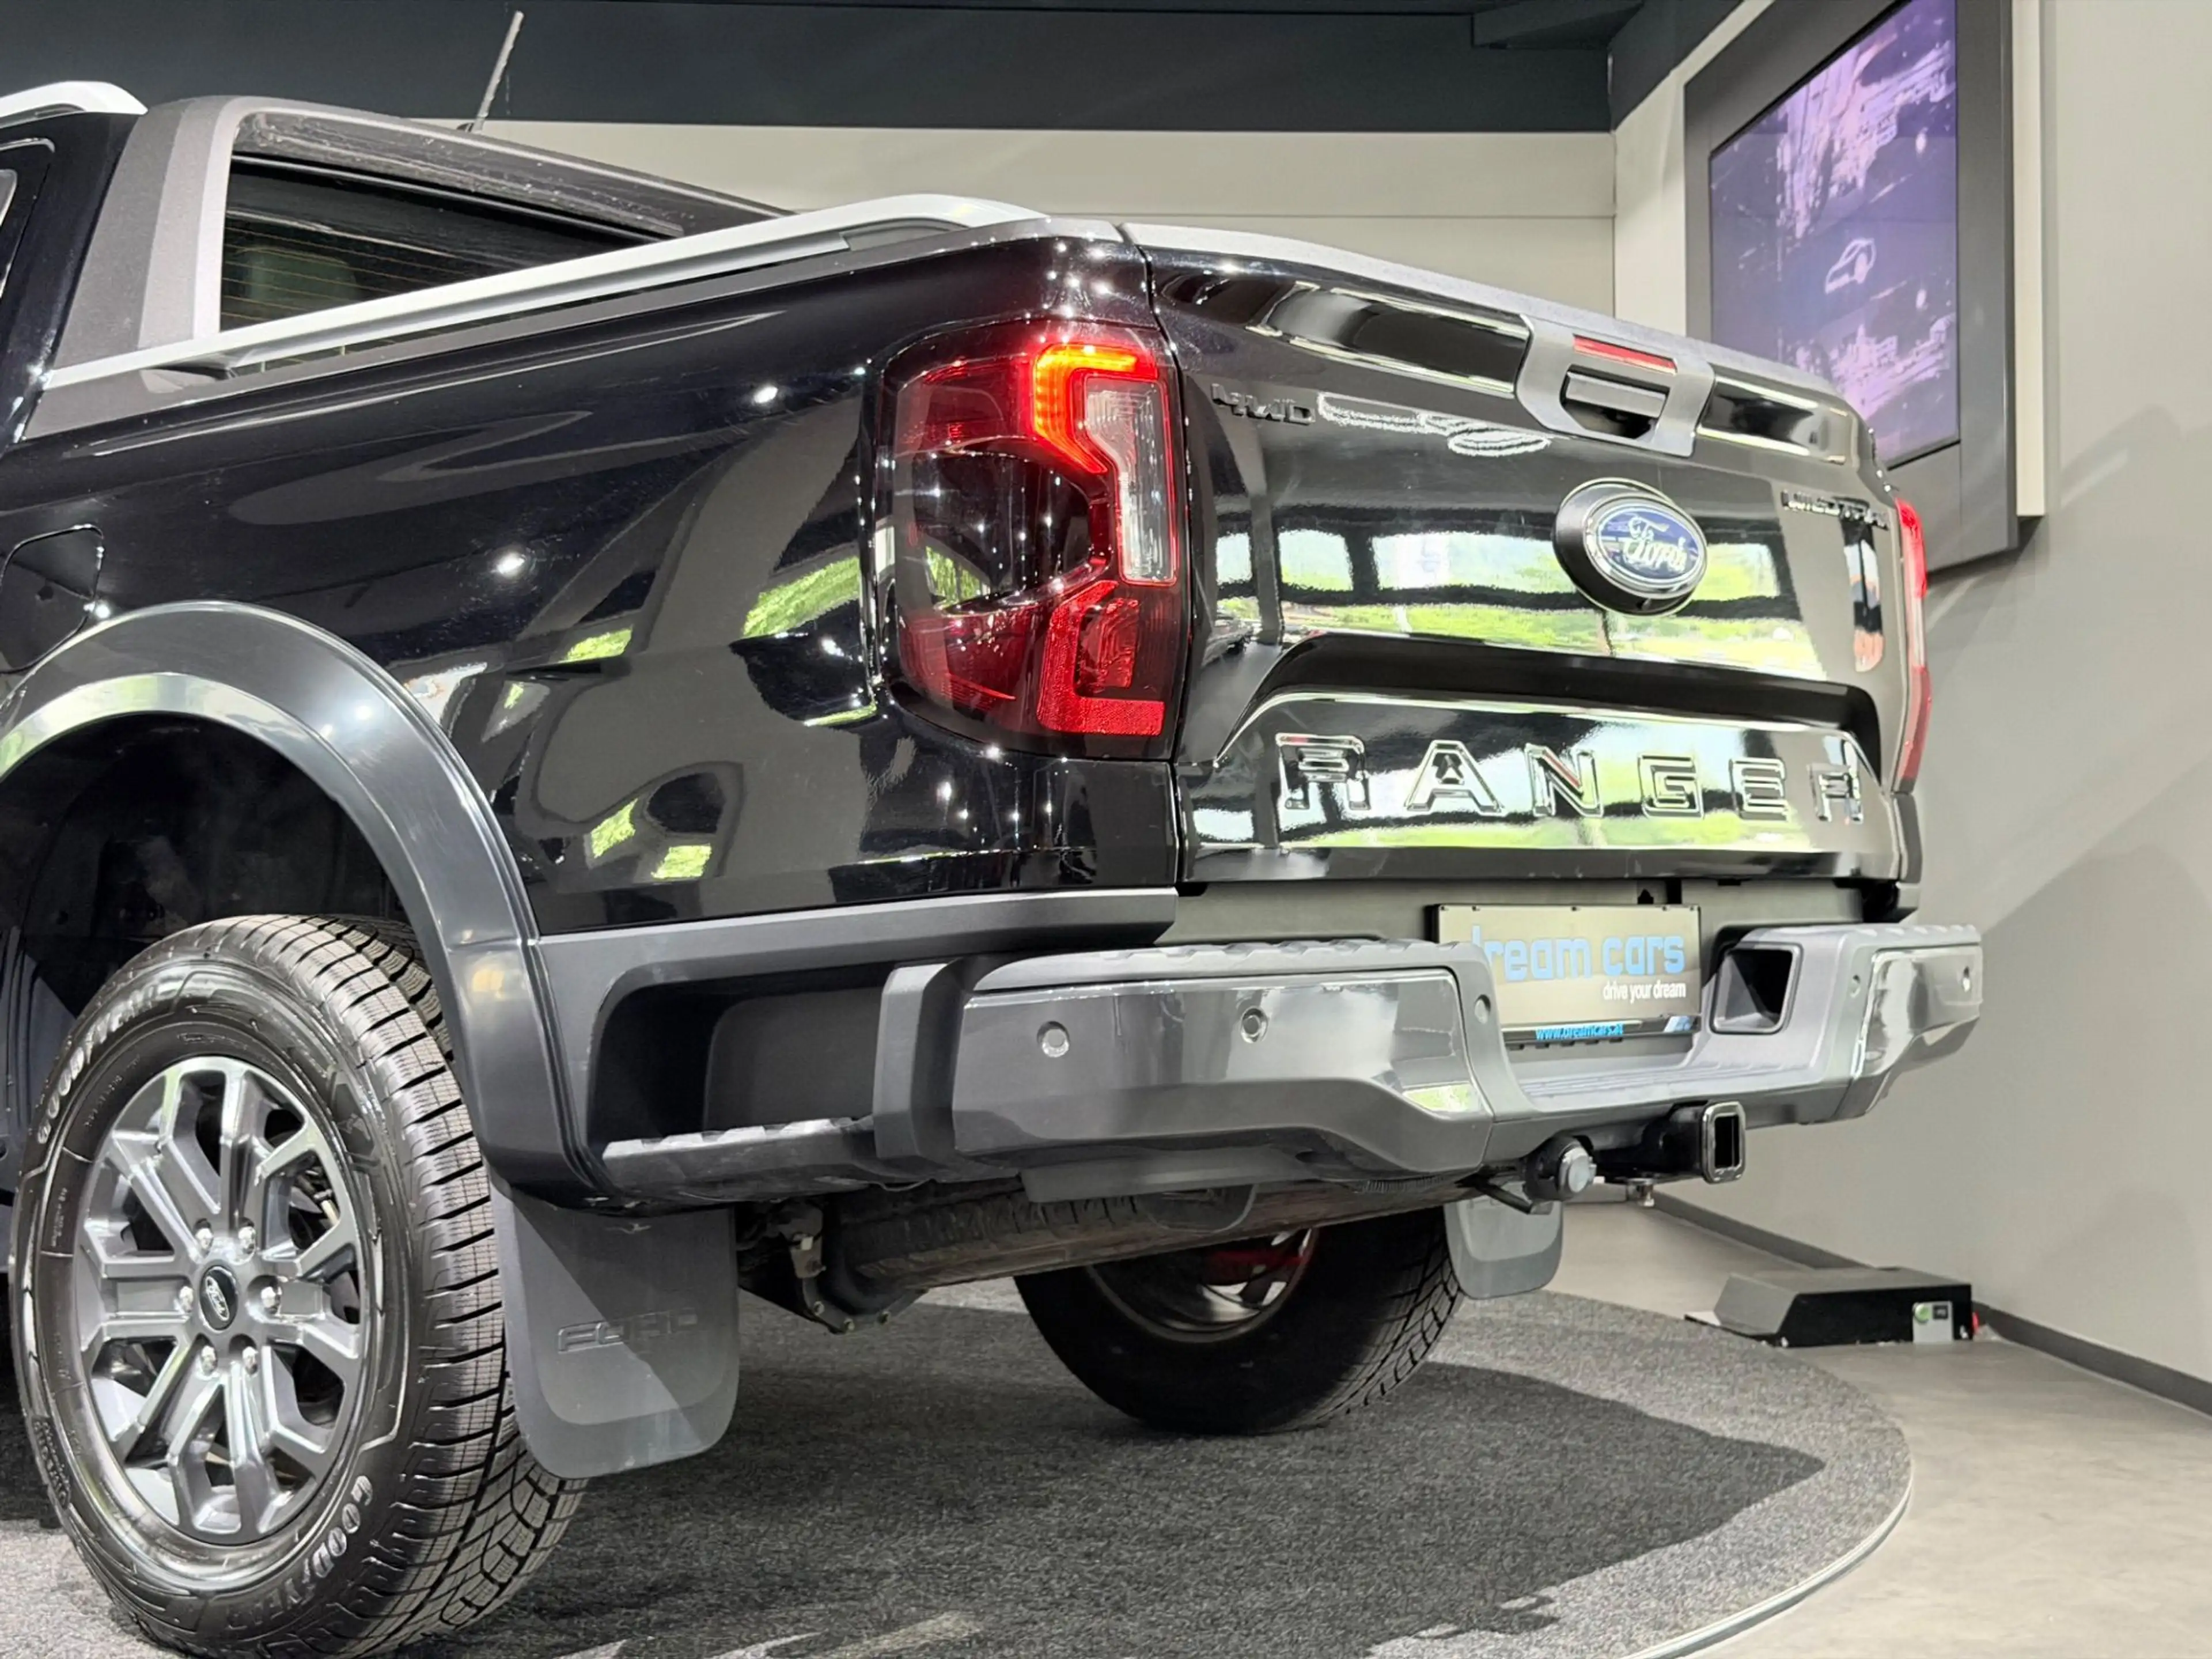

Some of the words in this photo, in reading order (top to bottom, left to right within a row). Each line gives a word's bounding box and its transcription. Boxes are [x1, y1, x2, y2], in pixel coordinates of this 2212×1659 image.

[1623, 517, 1688, 572] Ford
[1275, 732, 1863, 824] RANGER
[1602, 936, 1685, 976] cars
[1603, 980, 1628, 1001] drive
[1629, 984, 1652, 1005] your
[1653, 979, 1687, 999] dream
